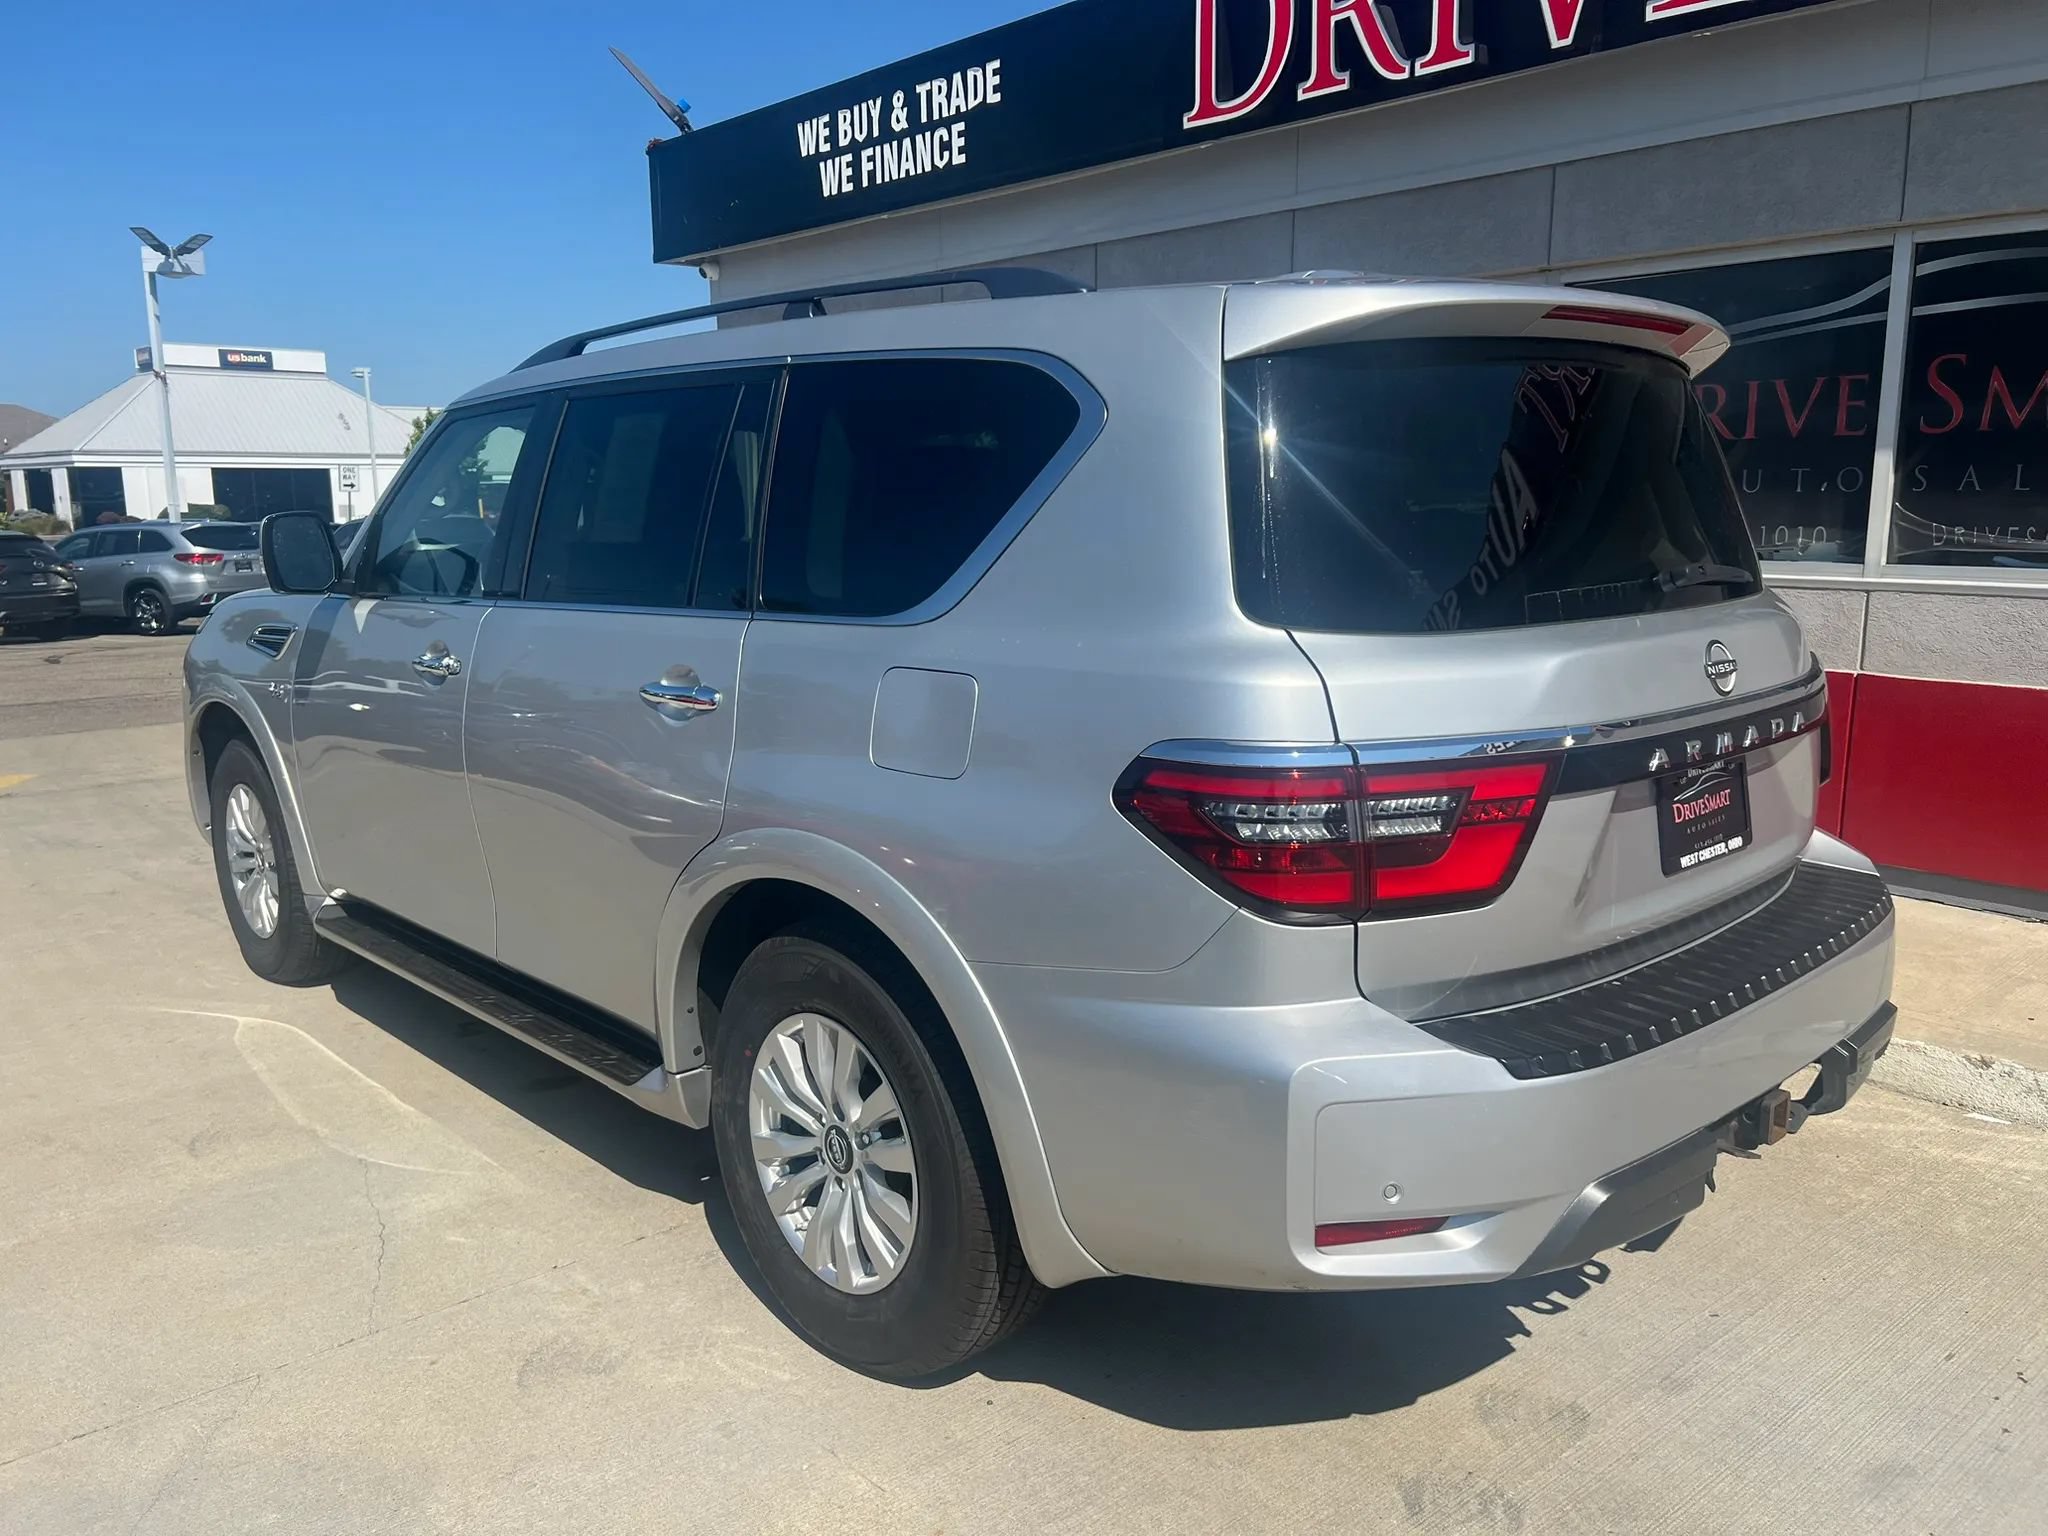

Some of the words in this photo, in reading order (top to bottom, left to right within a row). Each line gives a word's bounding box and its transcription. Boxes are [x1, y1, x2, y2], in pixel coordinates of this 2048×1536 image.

[797, 113, 831, 158] WE
[837, 96, 882, 148] BUY
[890, 89, 909, 132] &
[915, 58, 1002, 124] TRADE
[819, 153, 854, 198] WE
[861, 121, 967, 188] FINANCE
[342, 466, 356, 474] ONE
[1932, 522, 2048, 546] DRIVES
[1648, 711, 1806, 772] ARMADA
[1680, 851, 1699, 868] WEST
[1728, 836, 1743, 851] OHIO
